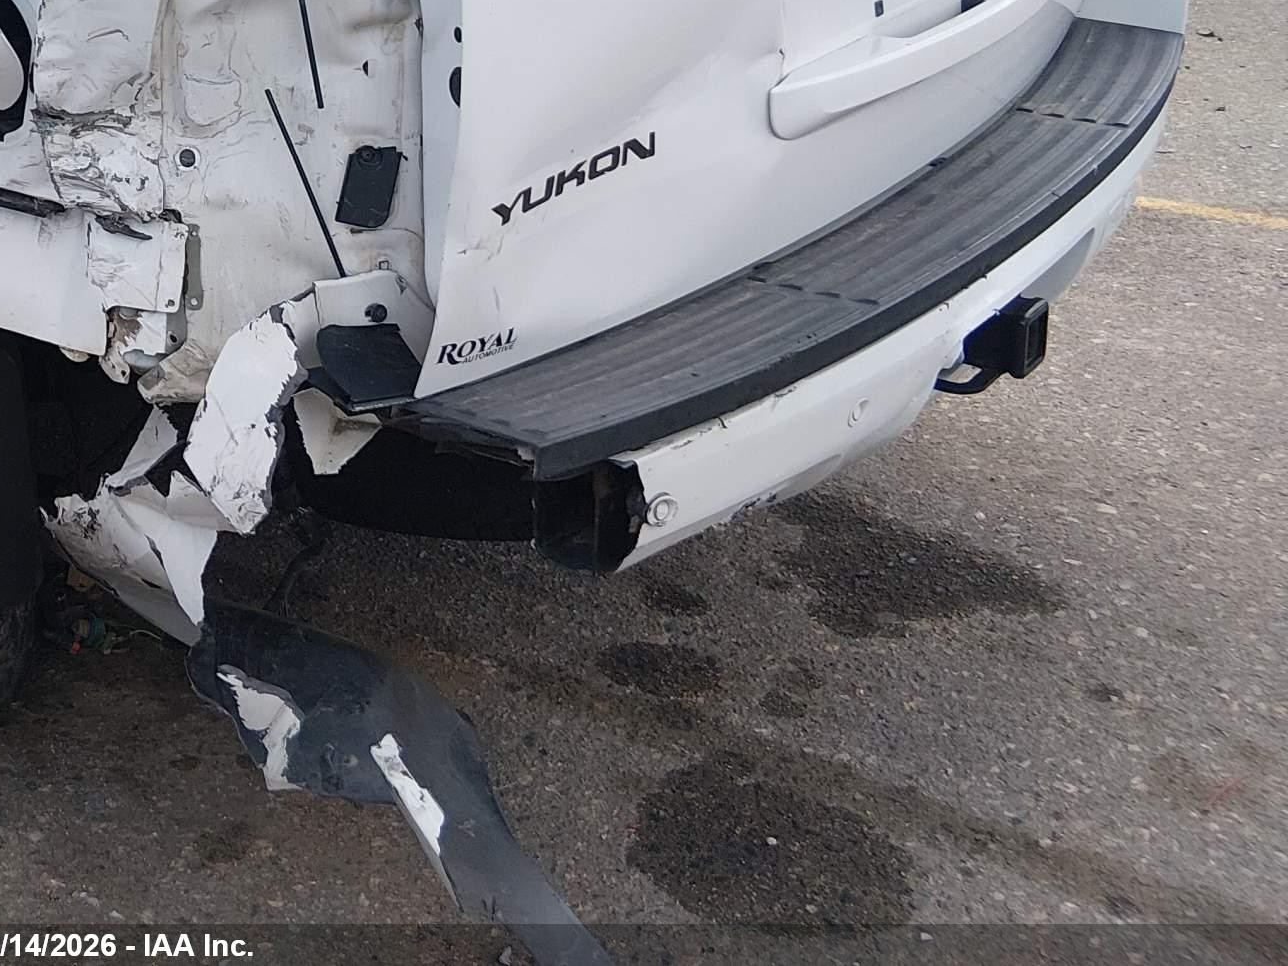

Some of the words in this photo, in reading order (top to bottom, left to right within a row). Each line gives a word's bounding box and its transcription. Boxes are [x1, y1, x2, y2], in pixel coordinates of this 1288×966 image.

[491, 131, 656, 226] YUKON
[436, 327, 518, 365] ROYAL
[462, 343, 516, 364] AUTOMOTIVE
